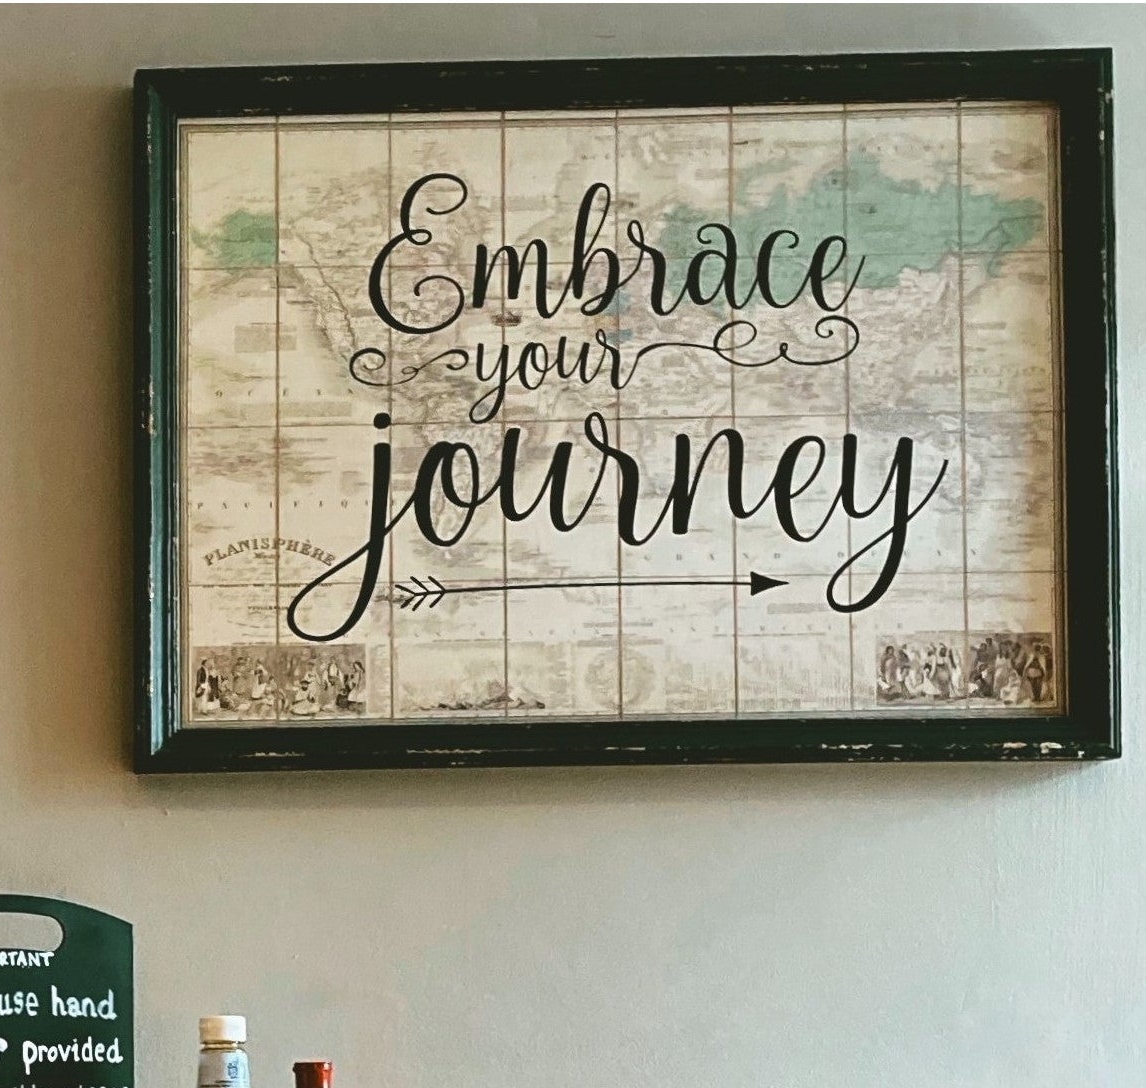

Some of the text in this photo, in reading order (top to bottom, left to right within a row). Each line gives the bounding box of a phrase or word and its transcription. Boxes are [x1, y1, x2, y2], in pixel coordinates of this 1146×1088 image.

[368, 172, 866, 335] Embrace
[469, 329, 642, 424] your
[204, 538, 336, 567] PLANISPHÈRE
[287, 411, 949, 642] journey
[51, 984, 118, 1020] hand
[22, 1036, 124, 1075] provided
